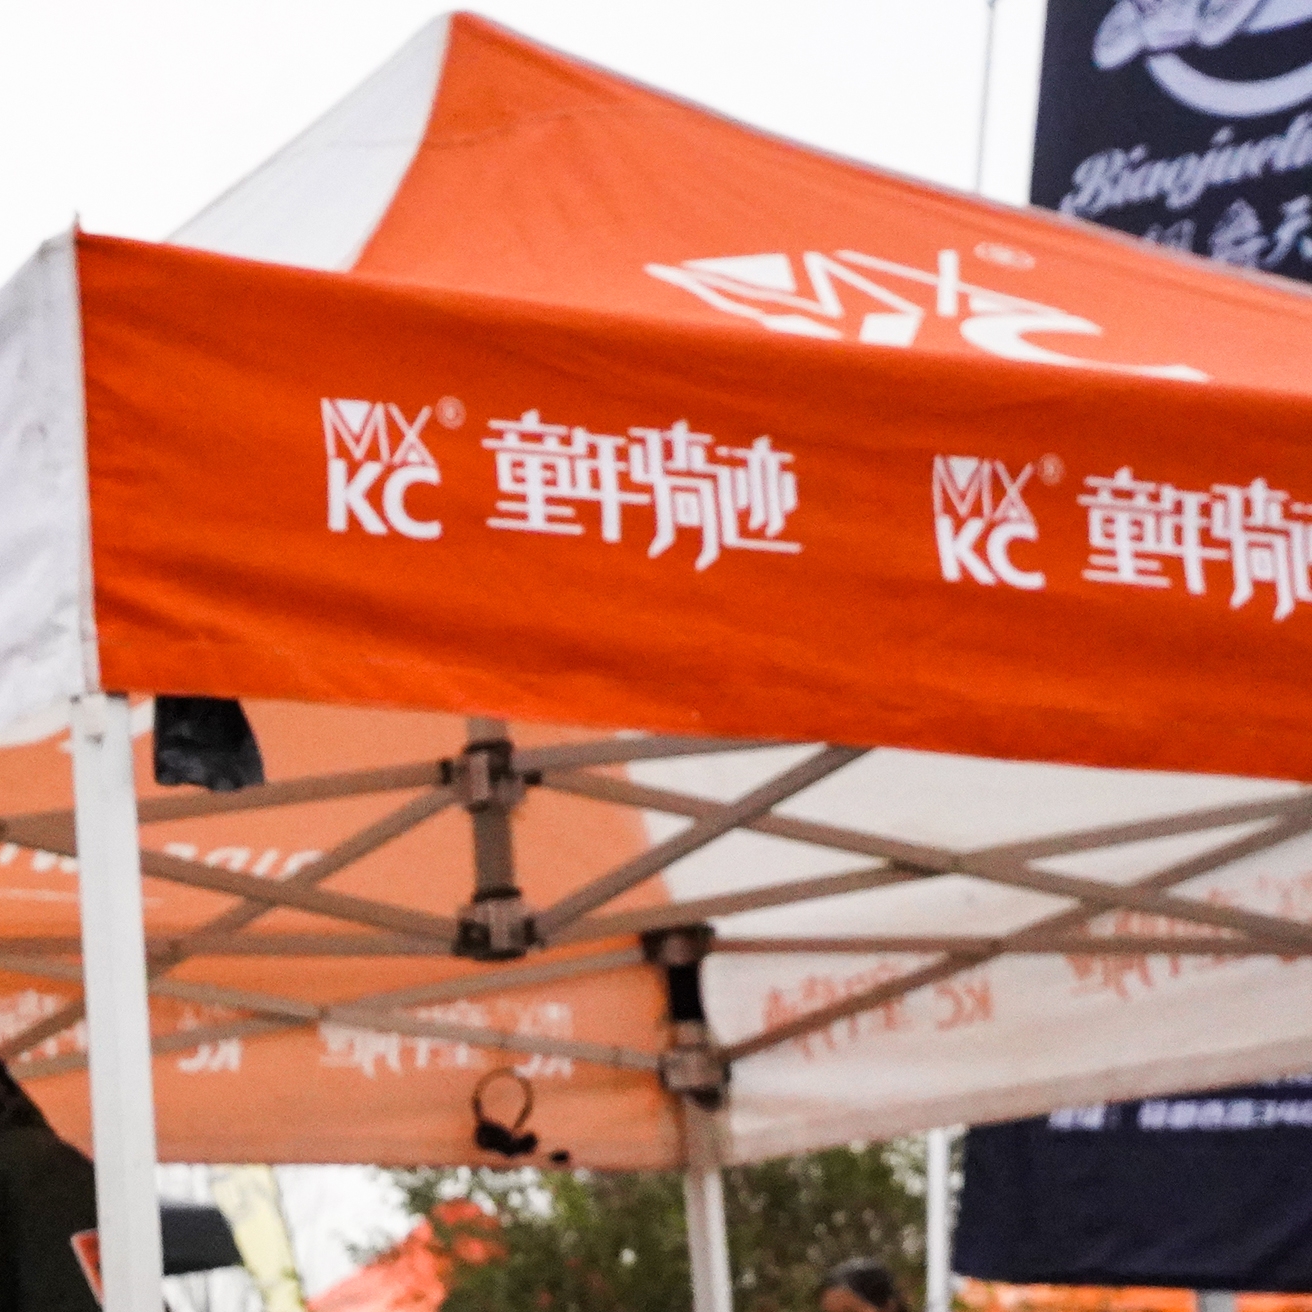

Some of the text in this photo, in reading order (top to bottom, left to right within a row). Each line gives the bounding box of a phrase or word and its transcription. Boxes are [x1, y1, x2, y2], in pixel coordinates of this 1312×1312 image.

[327, 457, 443, 540] KC
[481, 409, 803, 571] 童年骑迹
[1076, 466, 1312, 622] 童年骑
[937, 515, 1047, 591] KC
